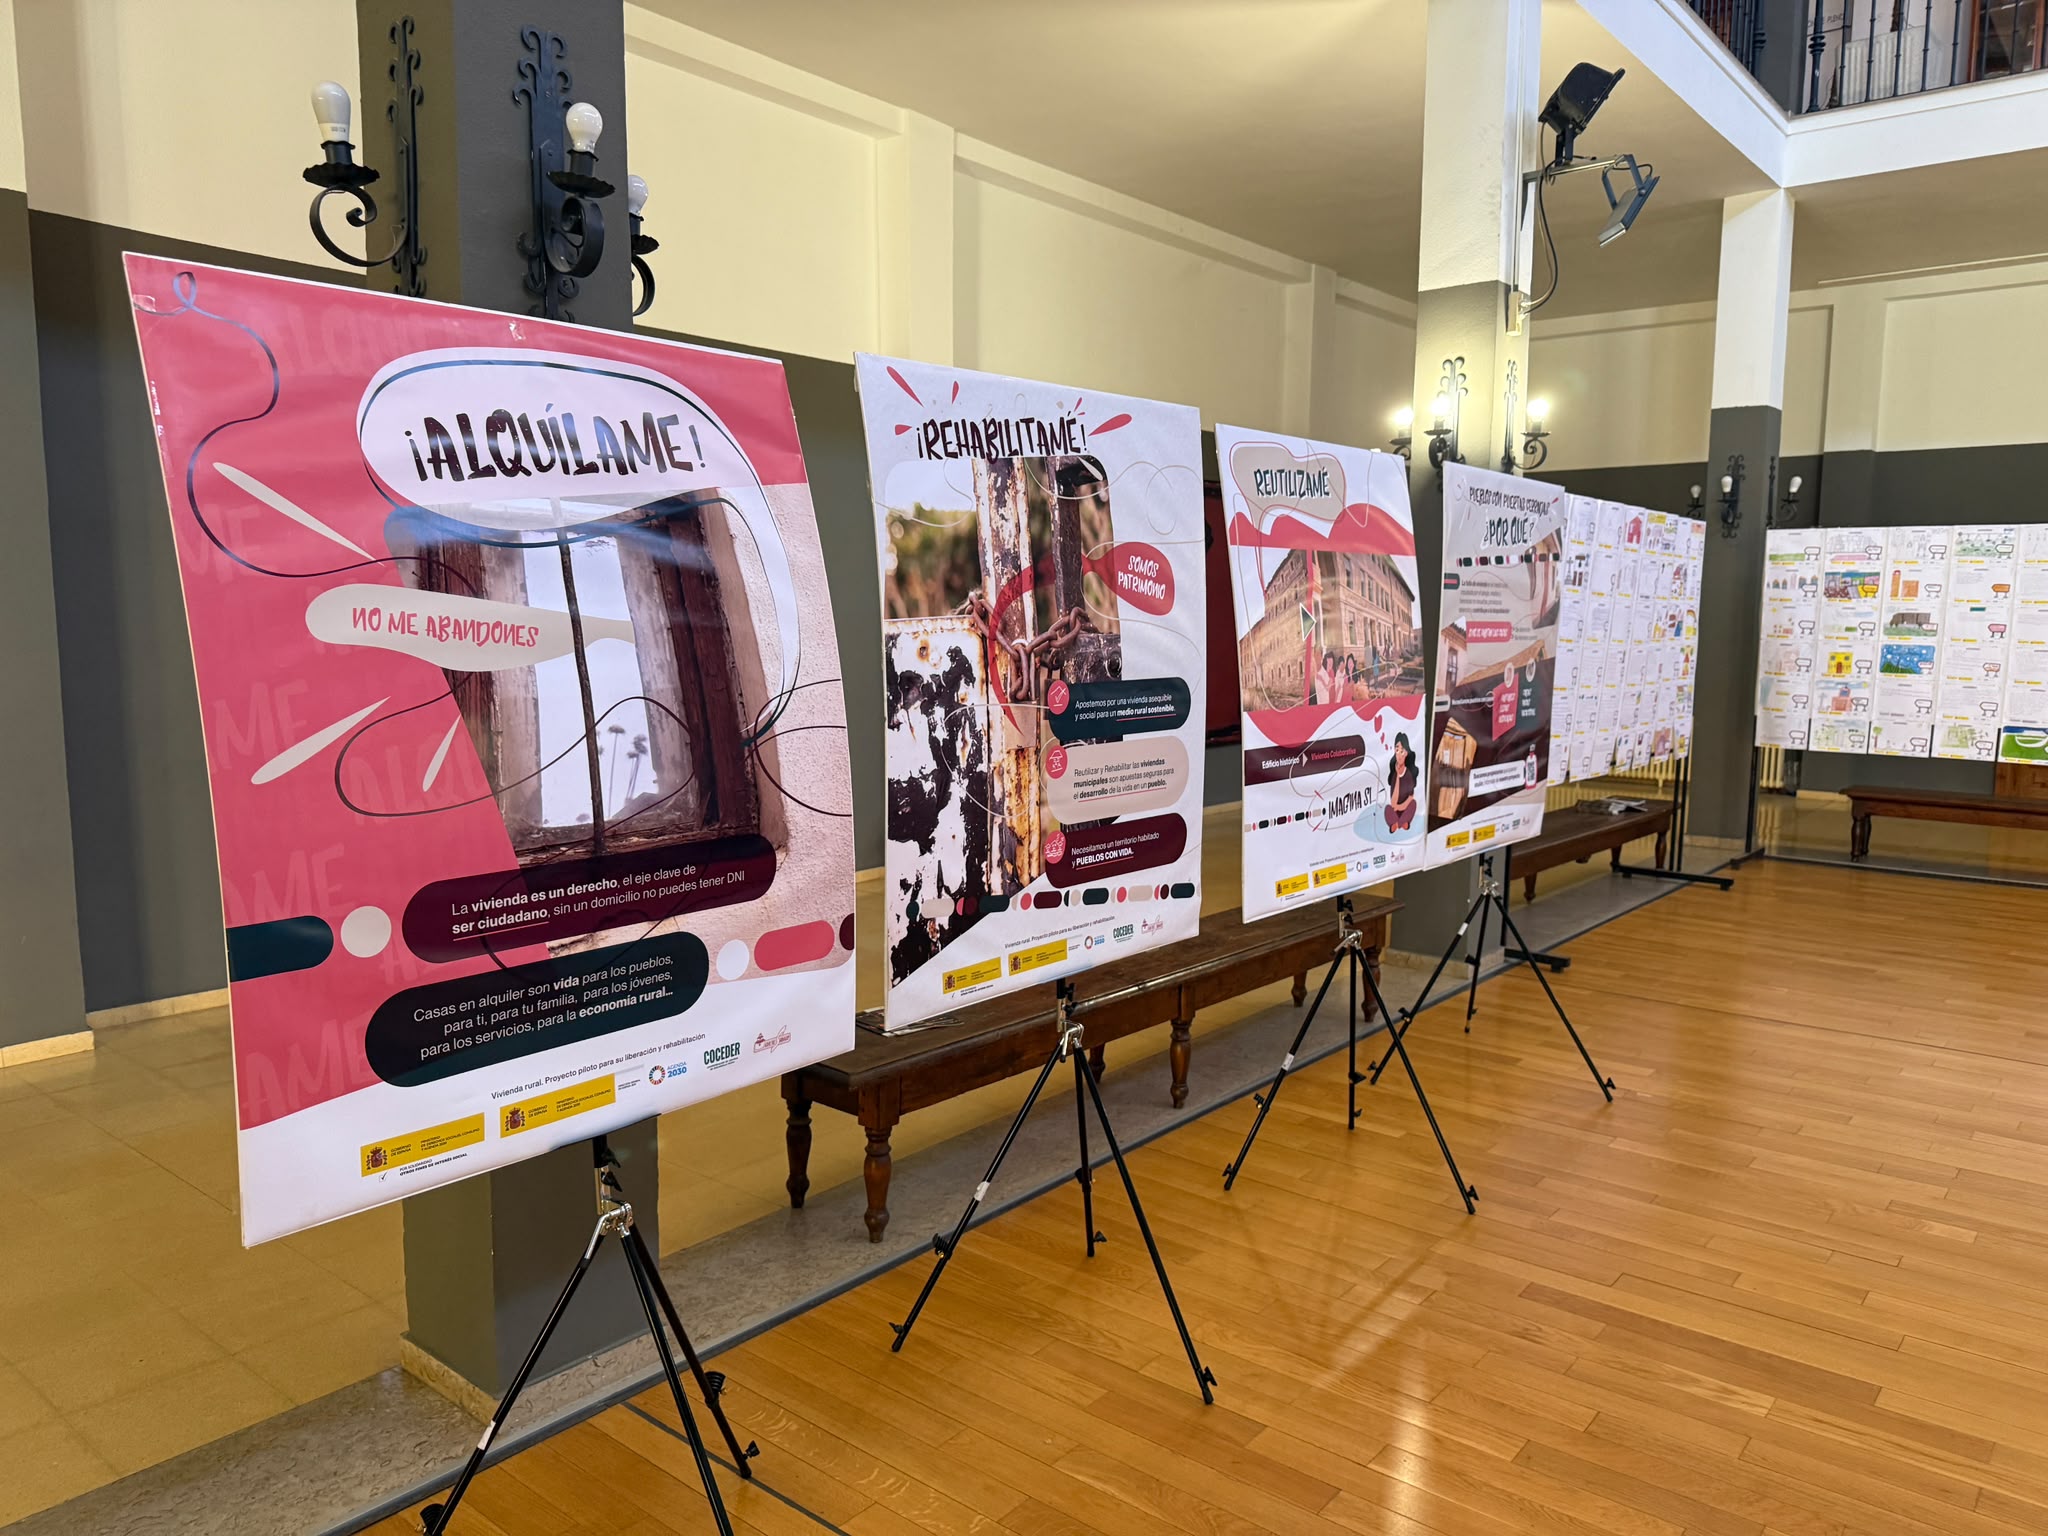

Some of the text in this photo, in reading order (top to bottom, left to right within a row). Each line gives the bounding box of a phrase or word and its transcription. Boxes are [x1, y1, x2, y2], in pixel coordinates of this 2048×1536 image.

[404, 402, 706, 482] ¡ALQUÍLAME!
[916, 411, 1088, 464] ¡REHABILITAMÉ!
[1128, 555, 1159, 577] SOMOS
[1118, 571, 1165, 599] PATRIMONIO
[353, 607, 539, 648] NO ME ABANDONES
[1075, 693, 1172, 709] Apostemos por una vivienda asequible
[1075, 713, 1079, 721] y
[1079, 711, 1096, 720] social
[1096, 711, 1109, 719] para
[1117, 707, 1134, 716] medio
[1134, 706, 1148, 714] rural
[1261, 755, 1300, 770] Edificio histórico
[1311, 751, 1330, 760] Vivienda
[1073, 768, 1175, 788] municipales son apuestas seguras para
[1074, 758, 1165, 777] Reutilizar y Rehabilitar las viviendas
[1073, 791, 1079, 800] el
[1079, 788, 1108, 799] desarrollo
[1109, 786, 1116, 794] de
[1116, 785, 1122, 793] la
[1122, 783, 1133, 792] vida
[1147, 779, 1167, 789] pueblo.
[1071, 843, 1106, 856] Necesitamos
[1114, 836, 1137, 847] territorio
[1137, 832, 1160, 842] habitado
[1076, 852, 1105, 866] PUEBLOS
[1104, 850, 1118, 860] CON
[1118, 847, 1134, 857] VIDA.
[451, 864, 697, 916] La vivienda es un derecho, el eje clave de
[452, 870, 745, 934] ser ciudadano, sin un domicilio no puedes tener DNI
[413, 955, 674, 1022] Casas en alquiler son vida para los pueblos,
[444, 971, 673, 1036] para ti, para tu familia, para los jóvenes,
[420, 1042, 451, 1061] para
[453, 1037, 473, 1050] los
[475, 1021, 535, 1044] servicios,
[537, 1014, 564, 1031] para
[566, 1010, 577, 1022] la
[703, 1042, 741, 1065] COCEDER
[491, 1033, 706, 1101] Vivienda rural. Proyecto piloto para su liberación y rehabilitación
[667, 1066, 688, 1078] 2030
